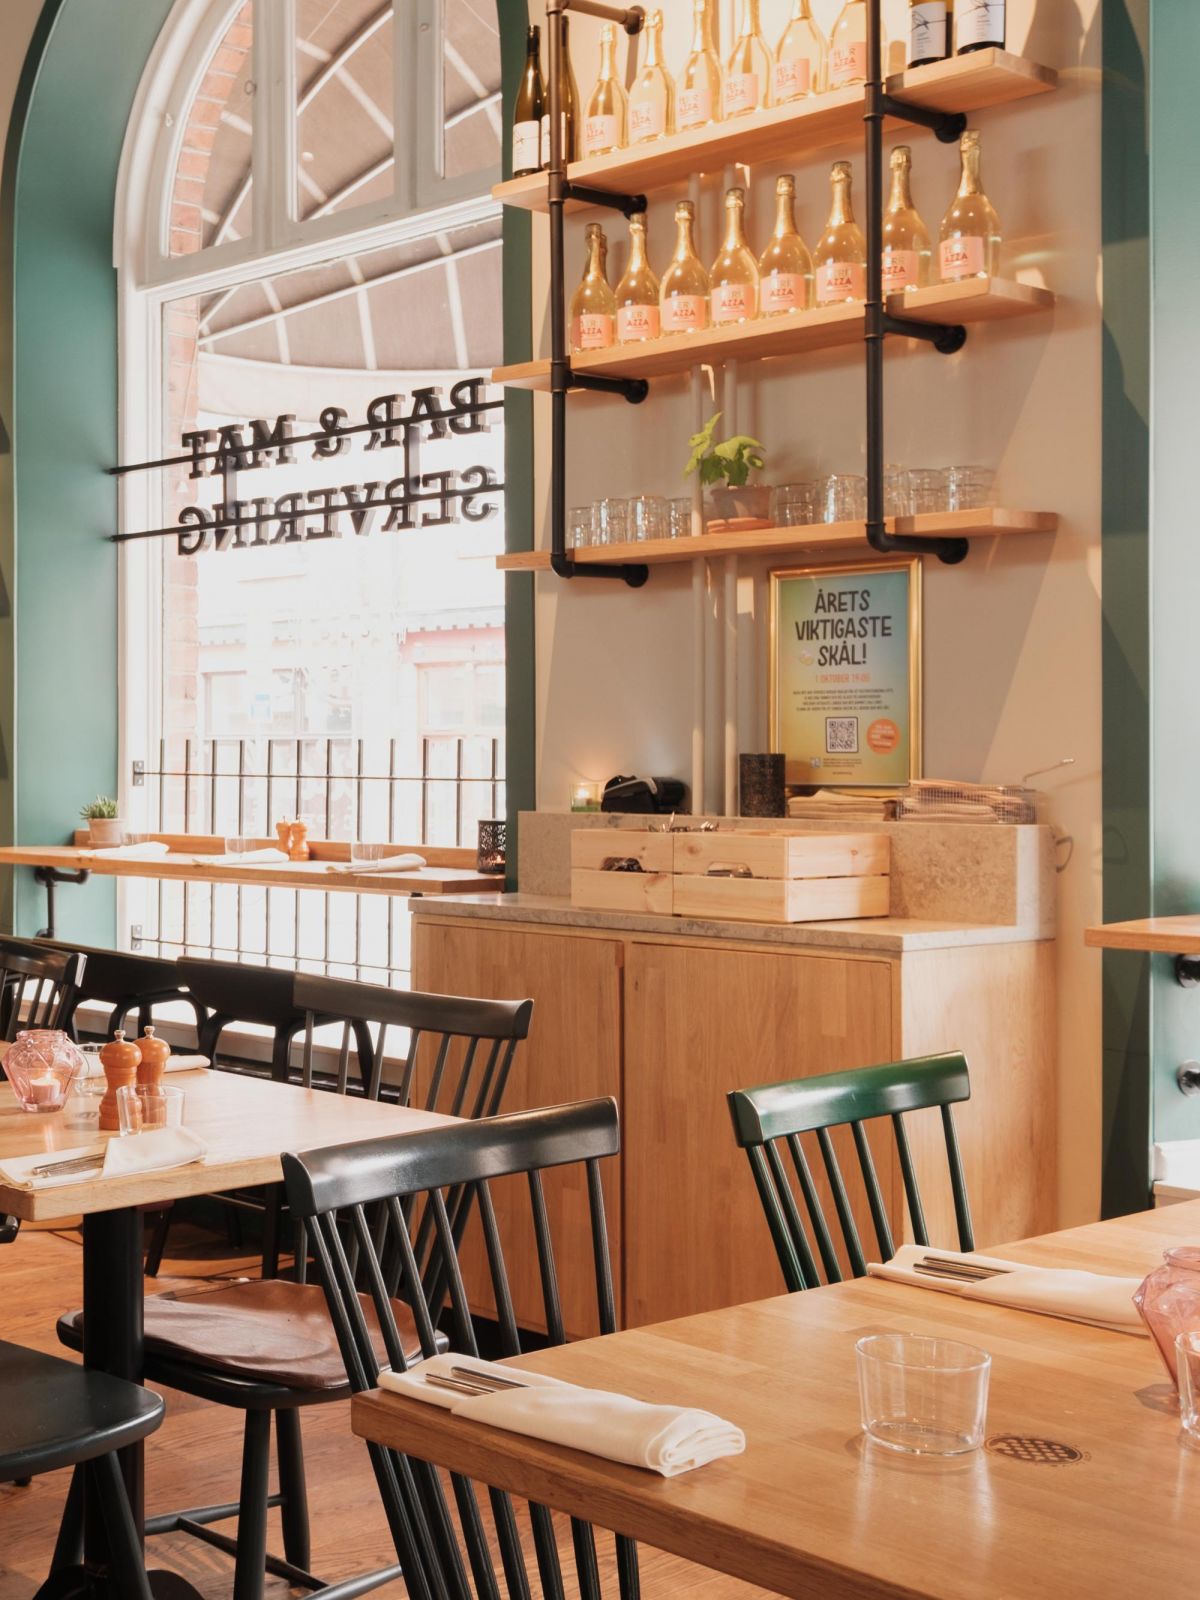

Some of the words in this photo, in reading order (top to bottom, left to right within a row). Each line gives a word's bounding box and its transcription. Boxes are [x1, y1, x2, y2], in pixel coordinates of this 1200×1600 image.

[814, 589, 871, 614] ÅRETS
[795, 615, 893, 641] VIKTIGASTE
[818, 640, 867, 667] SKÅL!
